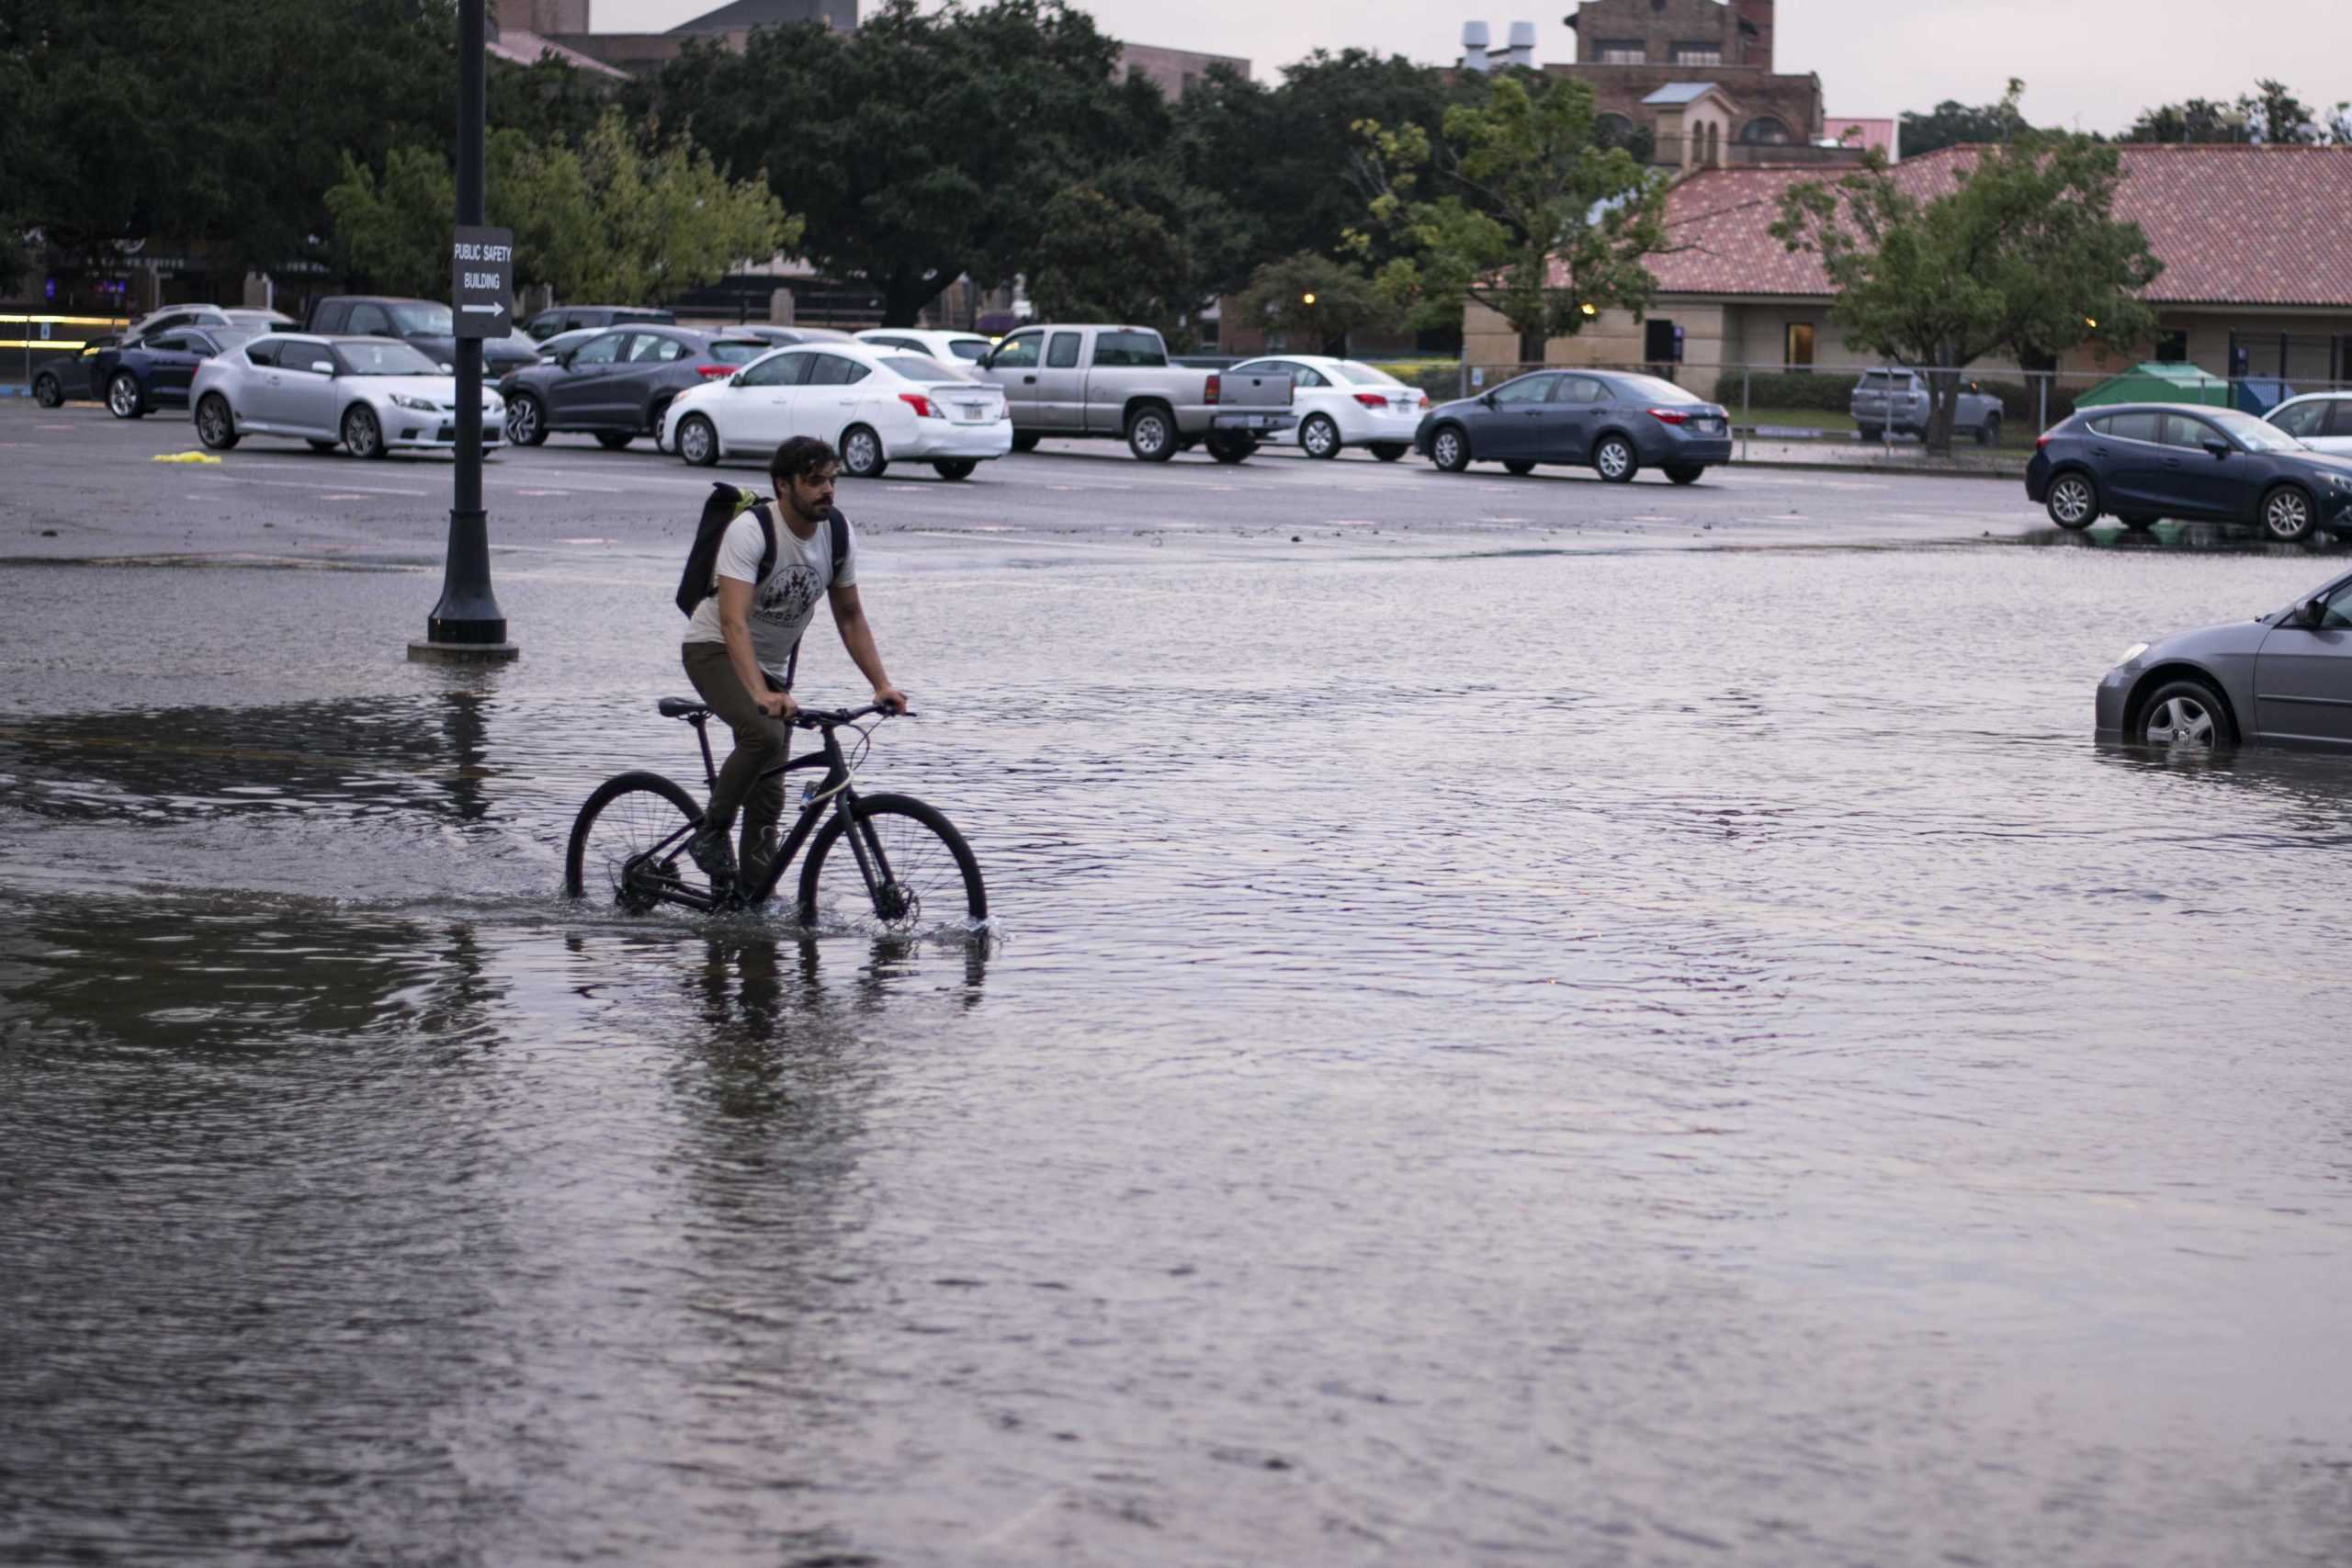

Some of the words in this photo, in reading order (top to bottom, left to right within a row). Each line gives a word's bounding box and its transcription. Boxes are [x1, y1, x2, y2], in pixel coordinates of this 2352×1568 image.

[455, 243, 481, 261] PUBLIC
[483, 245, 513, 262] SAFETY
[464, 272, 500, 289] BUILDING
